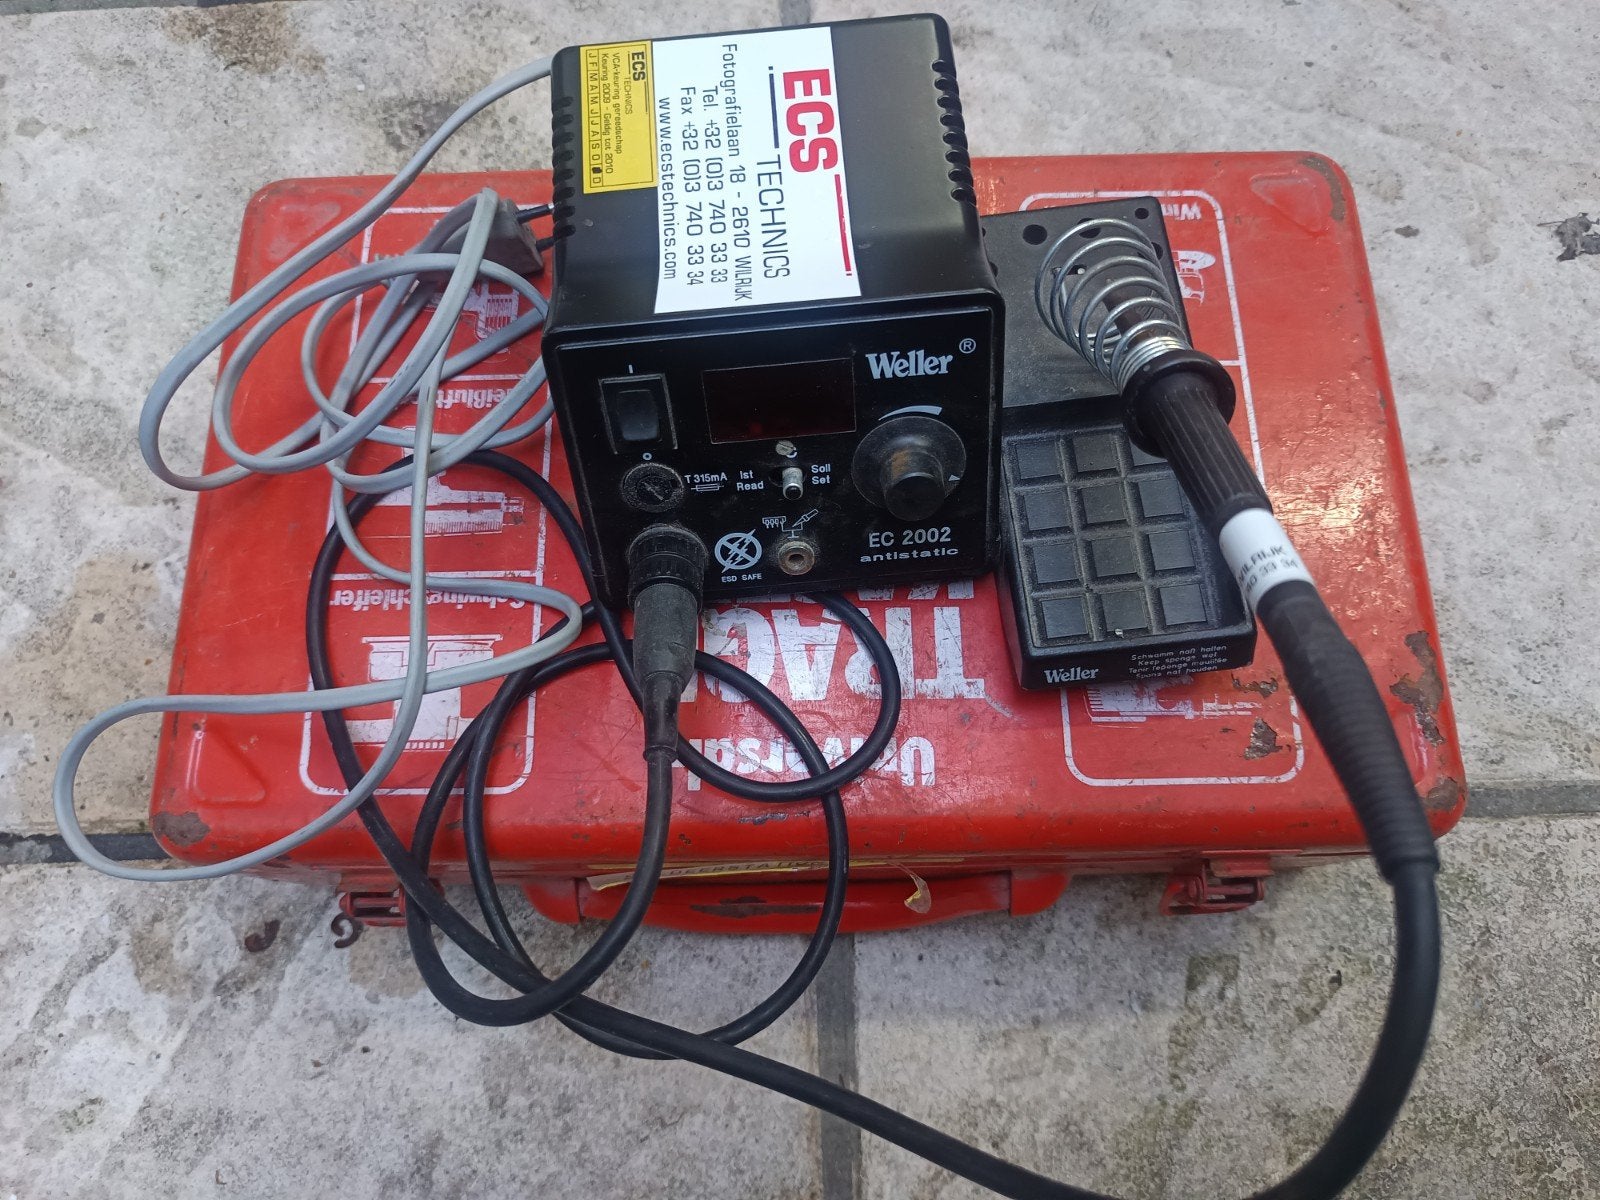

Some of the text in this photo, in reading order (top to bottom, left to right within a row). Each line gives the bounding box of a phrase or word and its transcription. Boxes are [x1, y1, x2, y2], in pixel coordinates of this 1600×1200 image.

[600, 53, 610, 82] Keuring
[631, 51, 646, 82] ECS
[602, 83, 611, 104] 2009
[623, 77, 633, 115] TECHNICS
[720, 43, 742, 157] Fotografielaan
[782, 68, 838, 173] ECS
[605, 153, 614, 174] 2010
[729, 165, 746, 184] 18
[658, 96, 679, 280] www.ecstechnics.com
[680, 86, 704, 286] Fax +32 (0)3 740 33 34
[702, 85, 728, 283] Tel. +32 (0)3 740 33 33
[732, 206, 751, 248] 2610
[756, 153, 790, 279] TECHNICS
[734, 255, 753, 301] WILRIJK
[865, 349, 953, 380] Weller
[684, 472, 728, 484] T 315mA
[739, 469, 754, 480] Ist
[811, 463, 831, 474] Soll
[811, 474, 831, 485] Set
[736, 480, 764, 491] Read
[868, 526, 951, 548] EC 2002
[859, 547, 959, 563] antistatic
[721, 572, 762, 583] ESD SAFE
[1131, 651, 1174, 661] Schwamm
[1043, 667, 1099, 684] Weller
